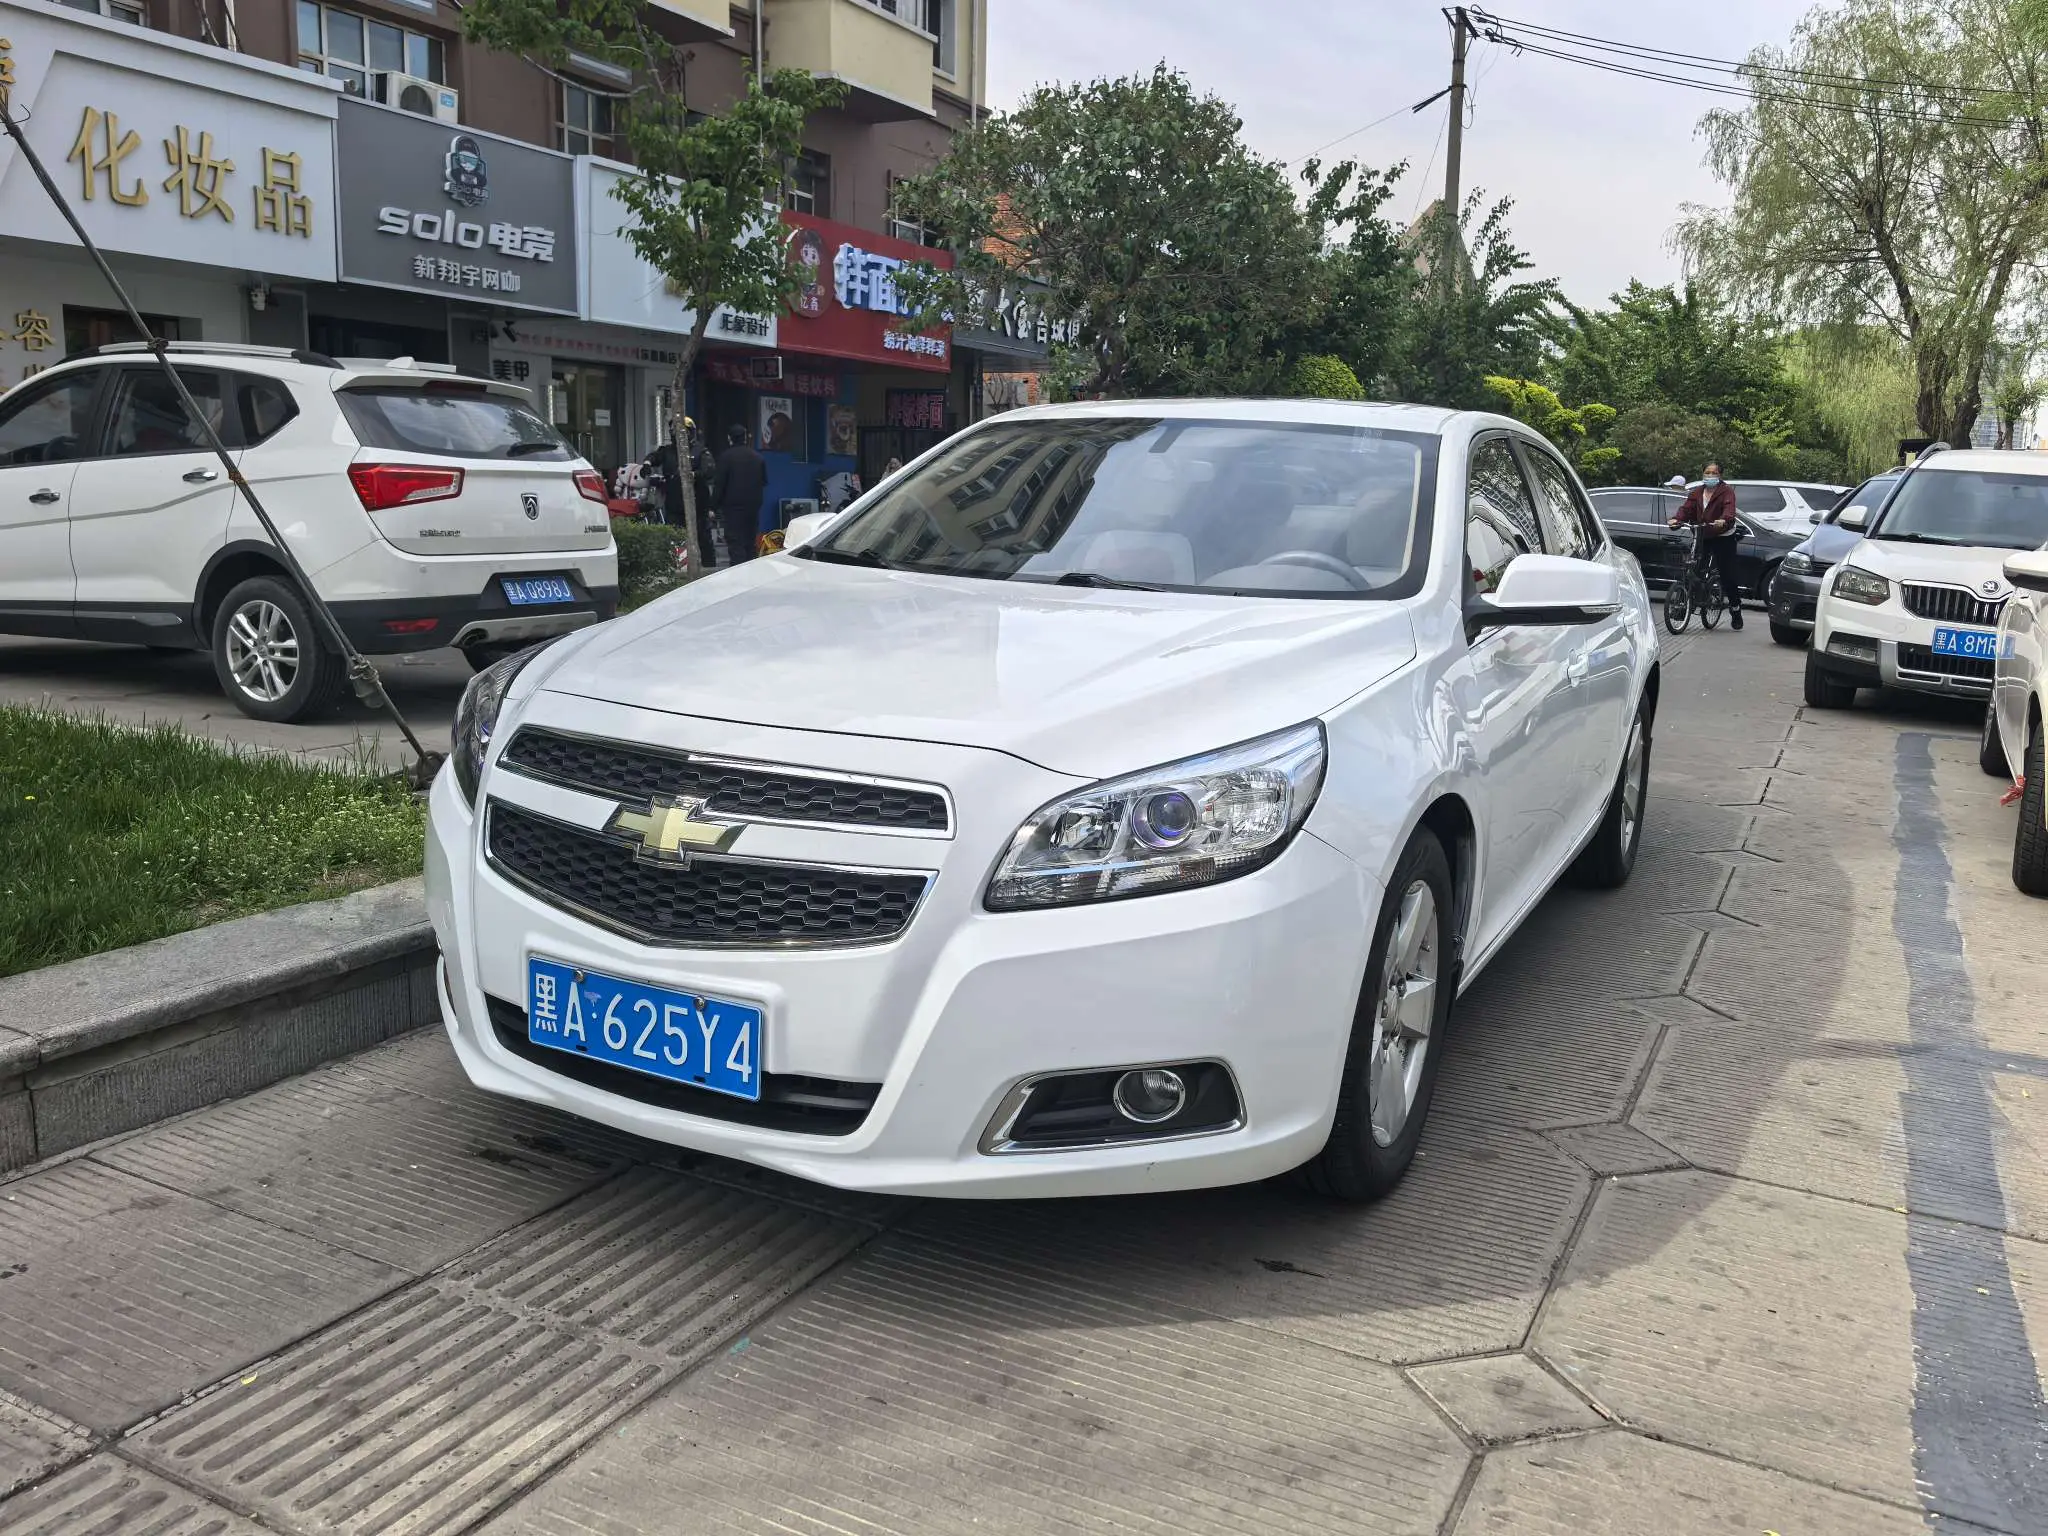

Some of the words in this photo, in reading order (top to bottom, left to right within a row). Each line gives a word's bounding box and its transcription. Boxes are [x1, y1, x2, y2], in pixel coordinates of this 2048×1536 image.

[67, 105, 313, 239] 化妆品
[487, 221, 556, 262] 电竞
[412, 254, 521, 293] 新翔宇网咖
[492, 359, 530, 382] 美甲
